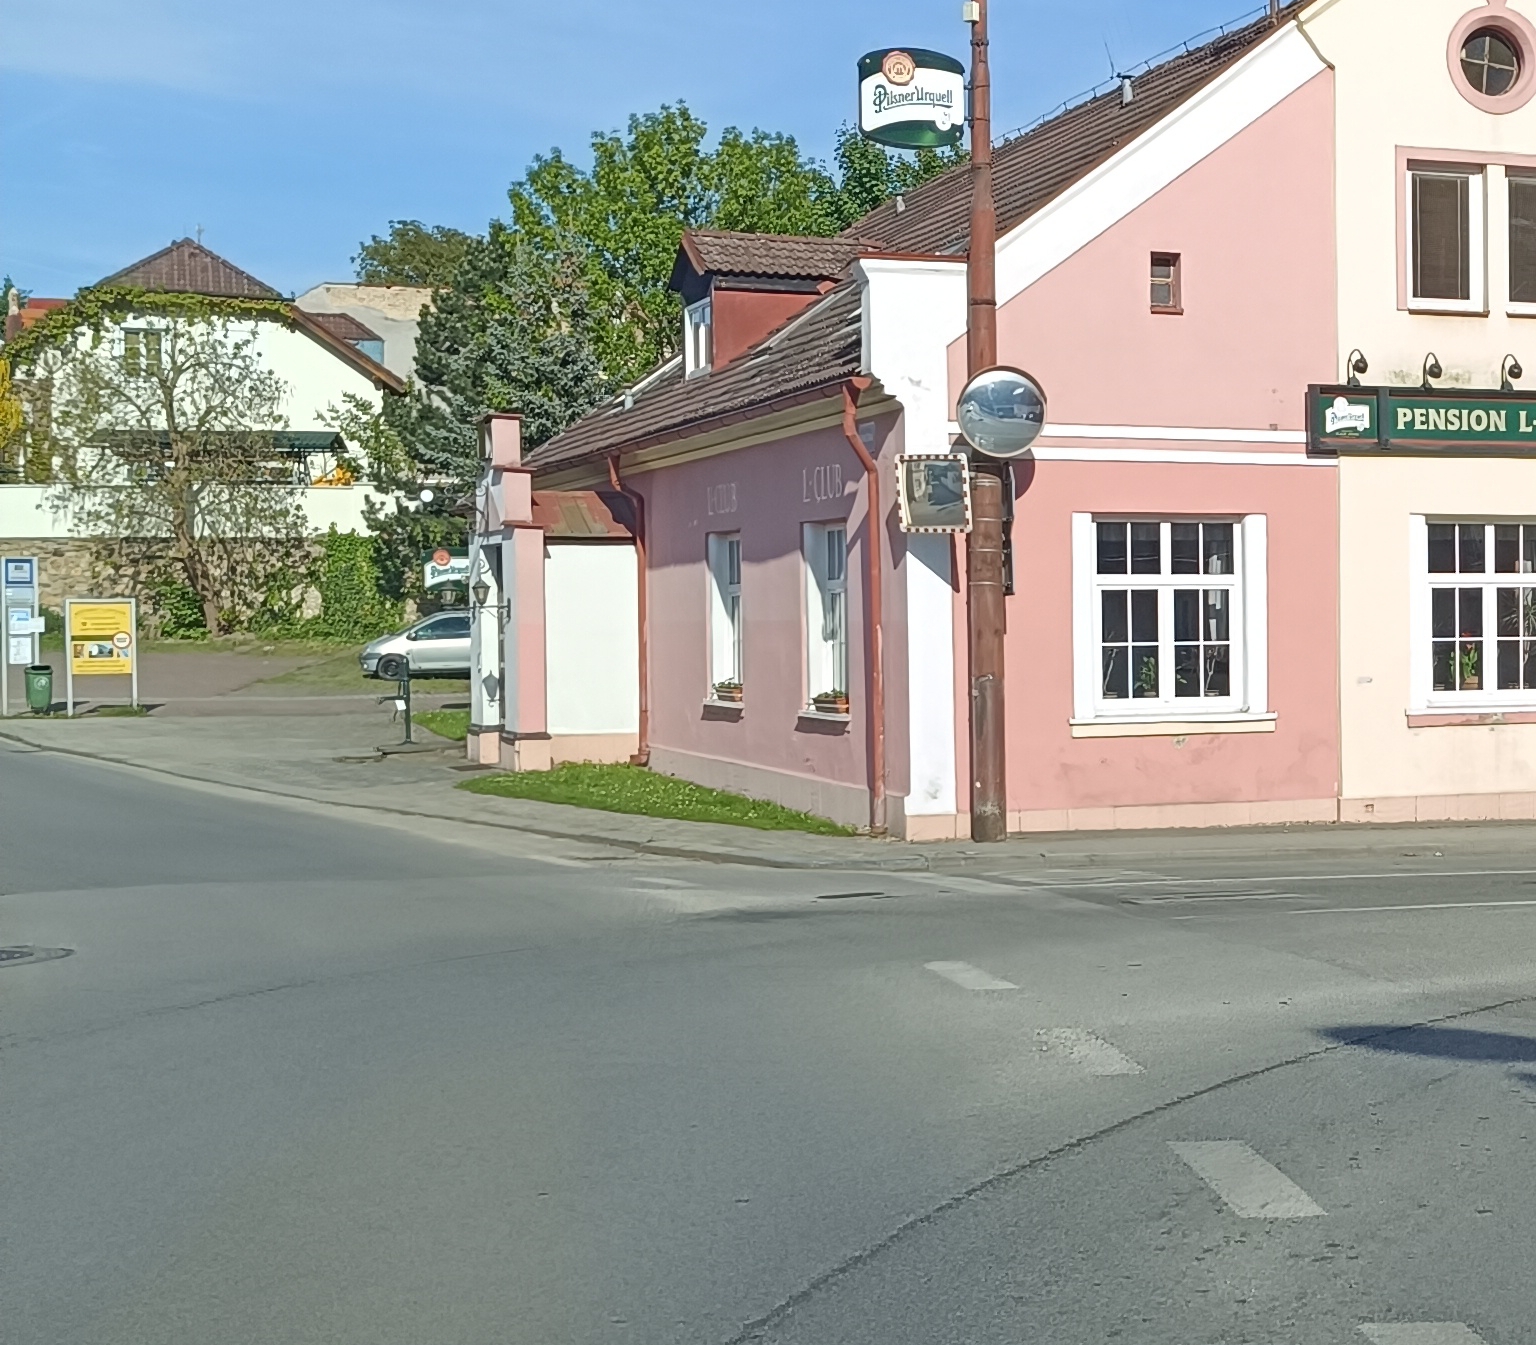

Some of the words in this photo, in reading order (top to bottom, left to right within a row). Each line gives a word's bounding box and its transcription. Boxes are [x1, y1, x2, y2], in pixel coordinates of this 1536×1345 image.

[873, 84, 915, 113] Pilsner
[915, 86, 953, 108] Urquell
[1397, 407, 1506, 432] PENSION
